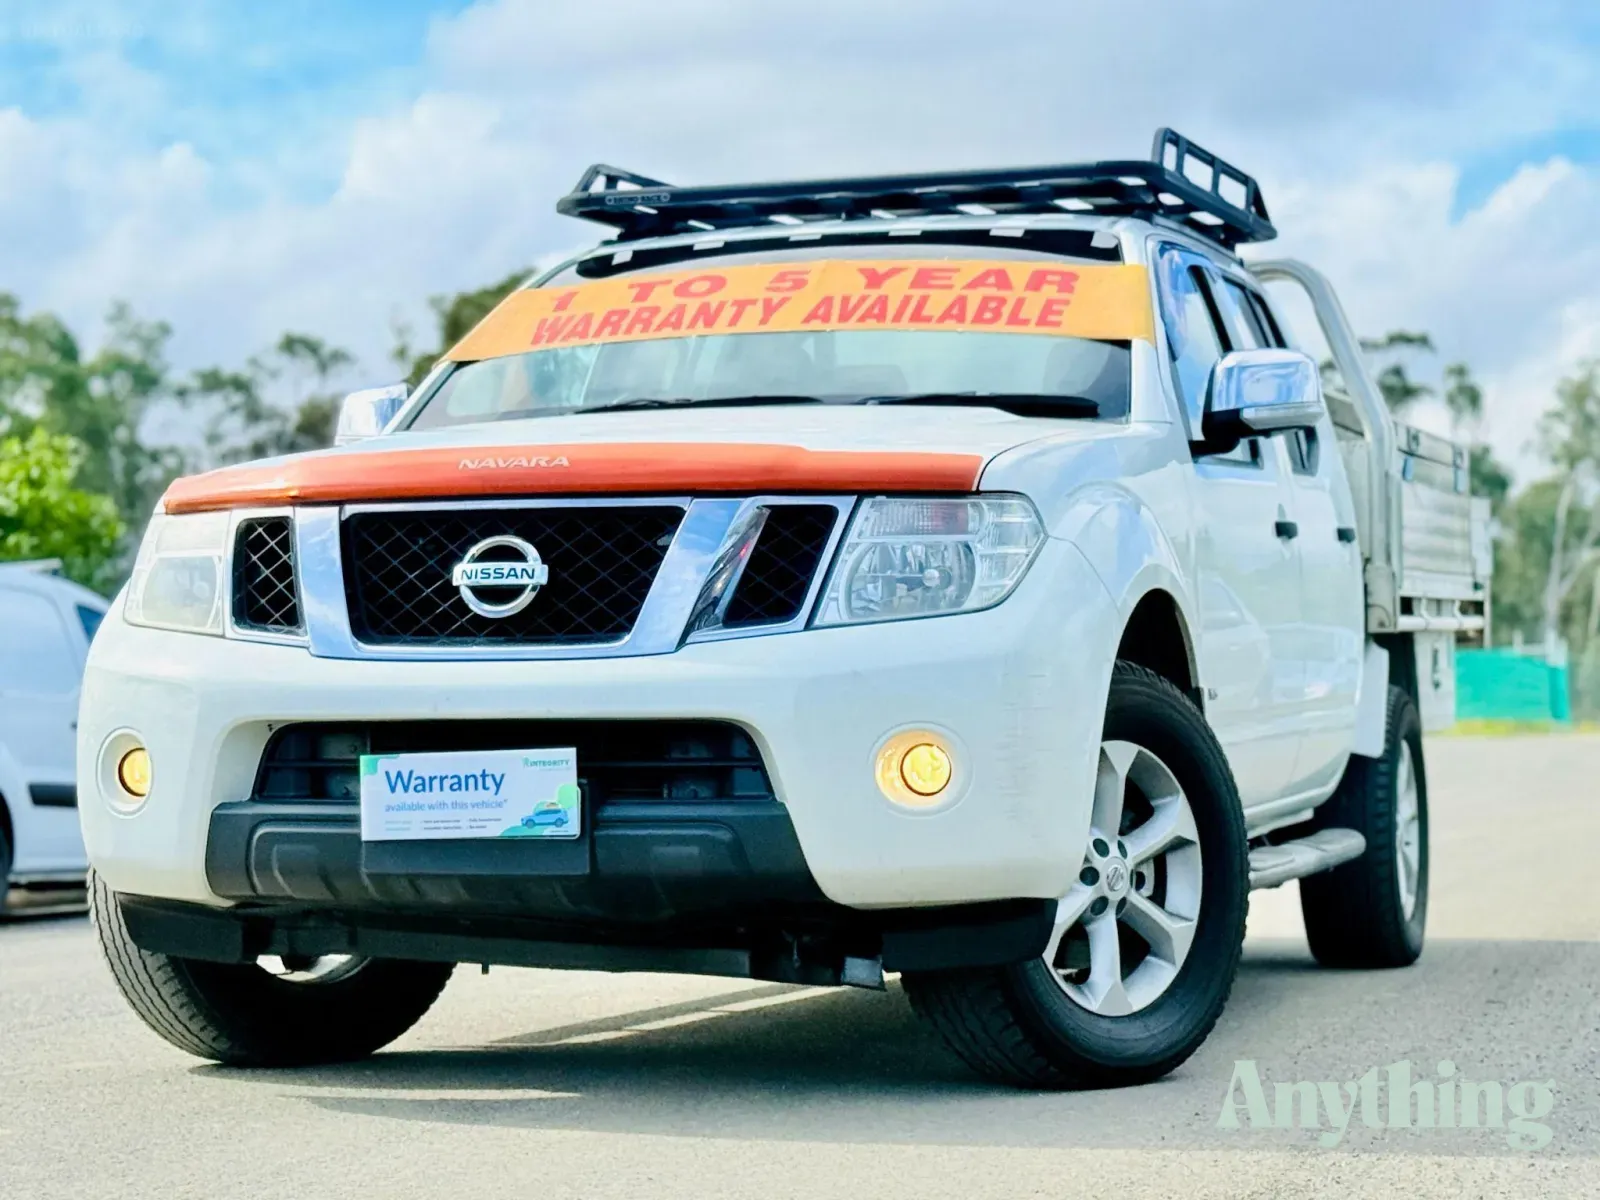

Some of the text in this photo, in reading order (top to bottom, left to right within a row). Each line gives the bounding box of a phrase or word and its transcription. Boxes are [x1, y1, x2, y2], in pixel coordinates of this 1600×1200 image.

[551, 266, 1079, 312] 1 TO 5 YEAR
[531, 294, 1073, 345] WARRANTY AVAILABLE
[459, 456, 570, 470] NAVARA
[461, 567, 536, 580] NISSAN
[385, 768, 506, 795] Warranty
[385, 801, 426, 812] available
[427, 800, 449, 810] with
[451, 799, 469, 809] this
